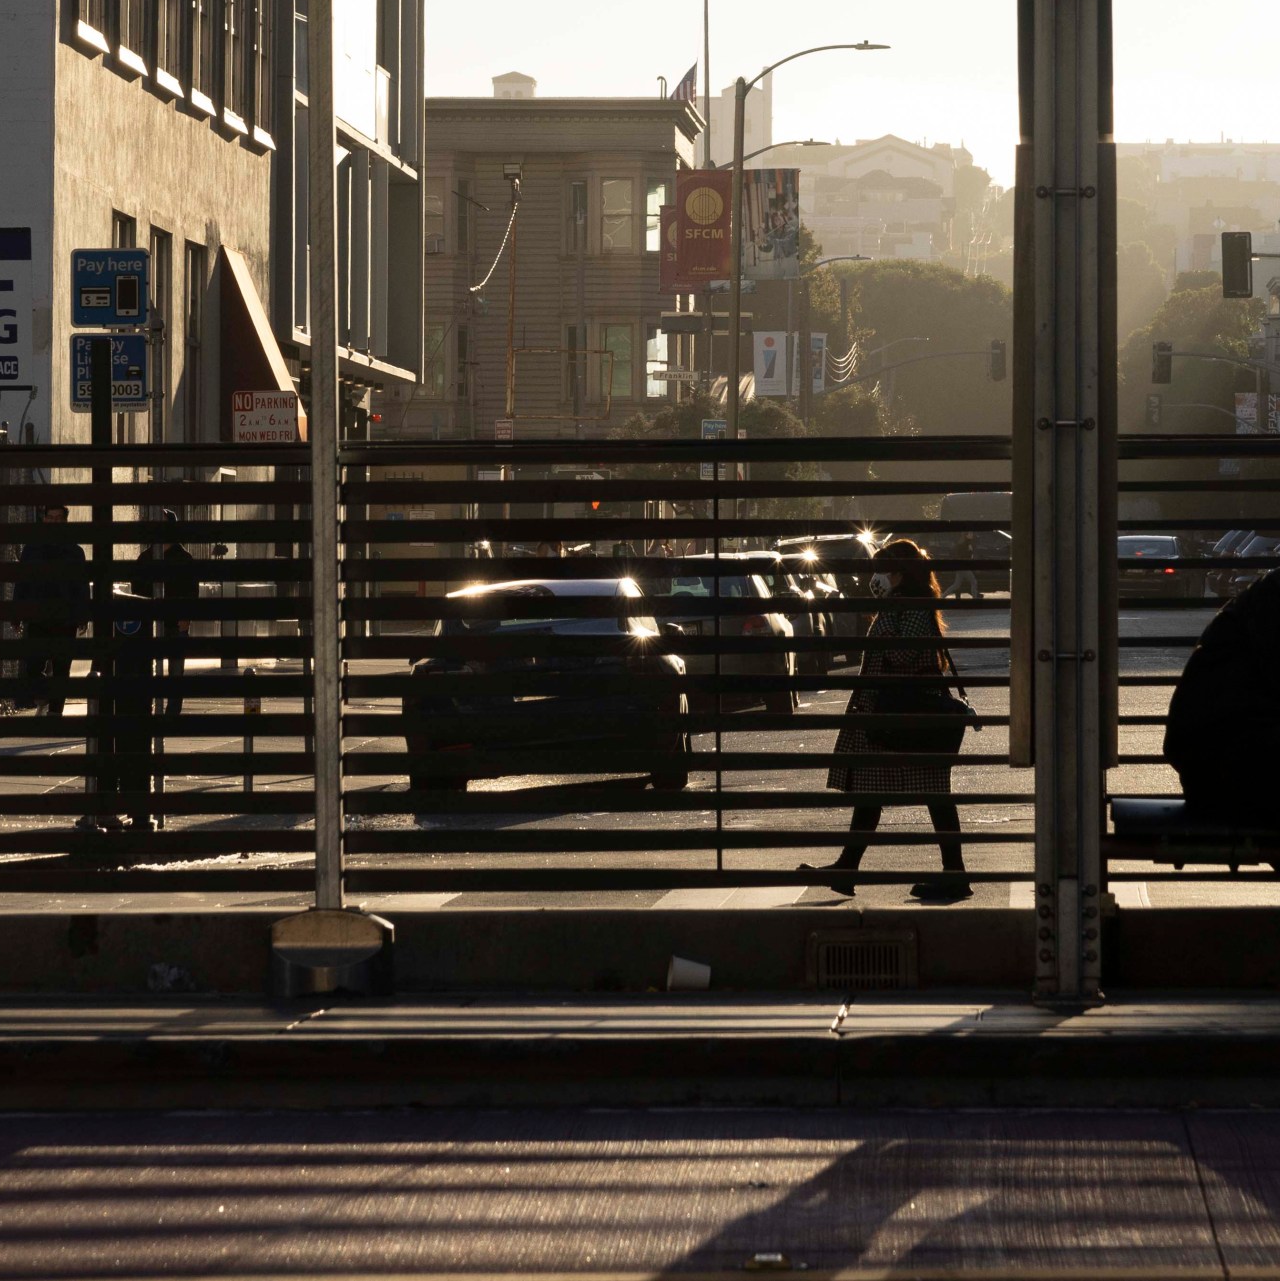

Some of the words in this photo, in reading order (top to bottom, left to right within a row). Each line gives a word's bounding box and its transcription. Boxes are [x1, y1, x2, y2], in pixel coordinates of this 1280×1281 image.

[685, 228, 723, 239] SFCM
[77, 258, 105, 275] Pay
[108, 257, 142, 271] here
[76, 338, 91, 350] Pa
[77, 352, 128, 365] Lise
[80, 384, 140, 396] 590003
[235, 393, 252, 409] NO
[255, 397, 294, 409] PARKING
[240, 414, 246, 426] 2
[269, 414, 276, 426] 6
[239, 431, 257, 441] MON
[259, 431, 277, 441] WED
[280, 430, 292, 441] FRI
